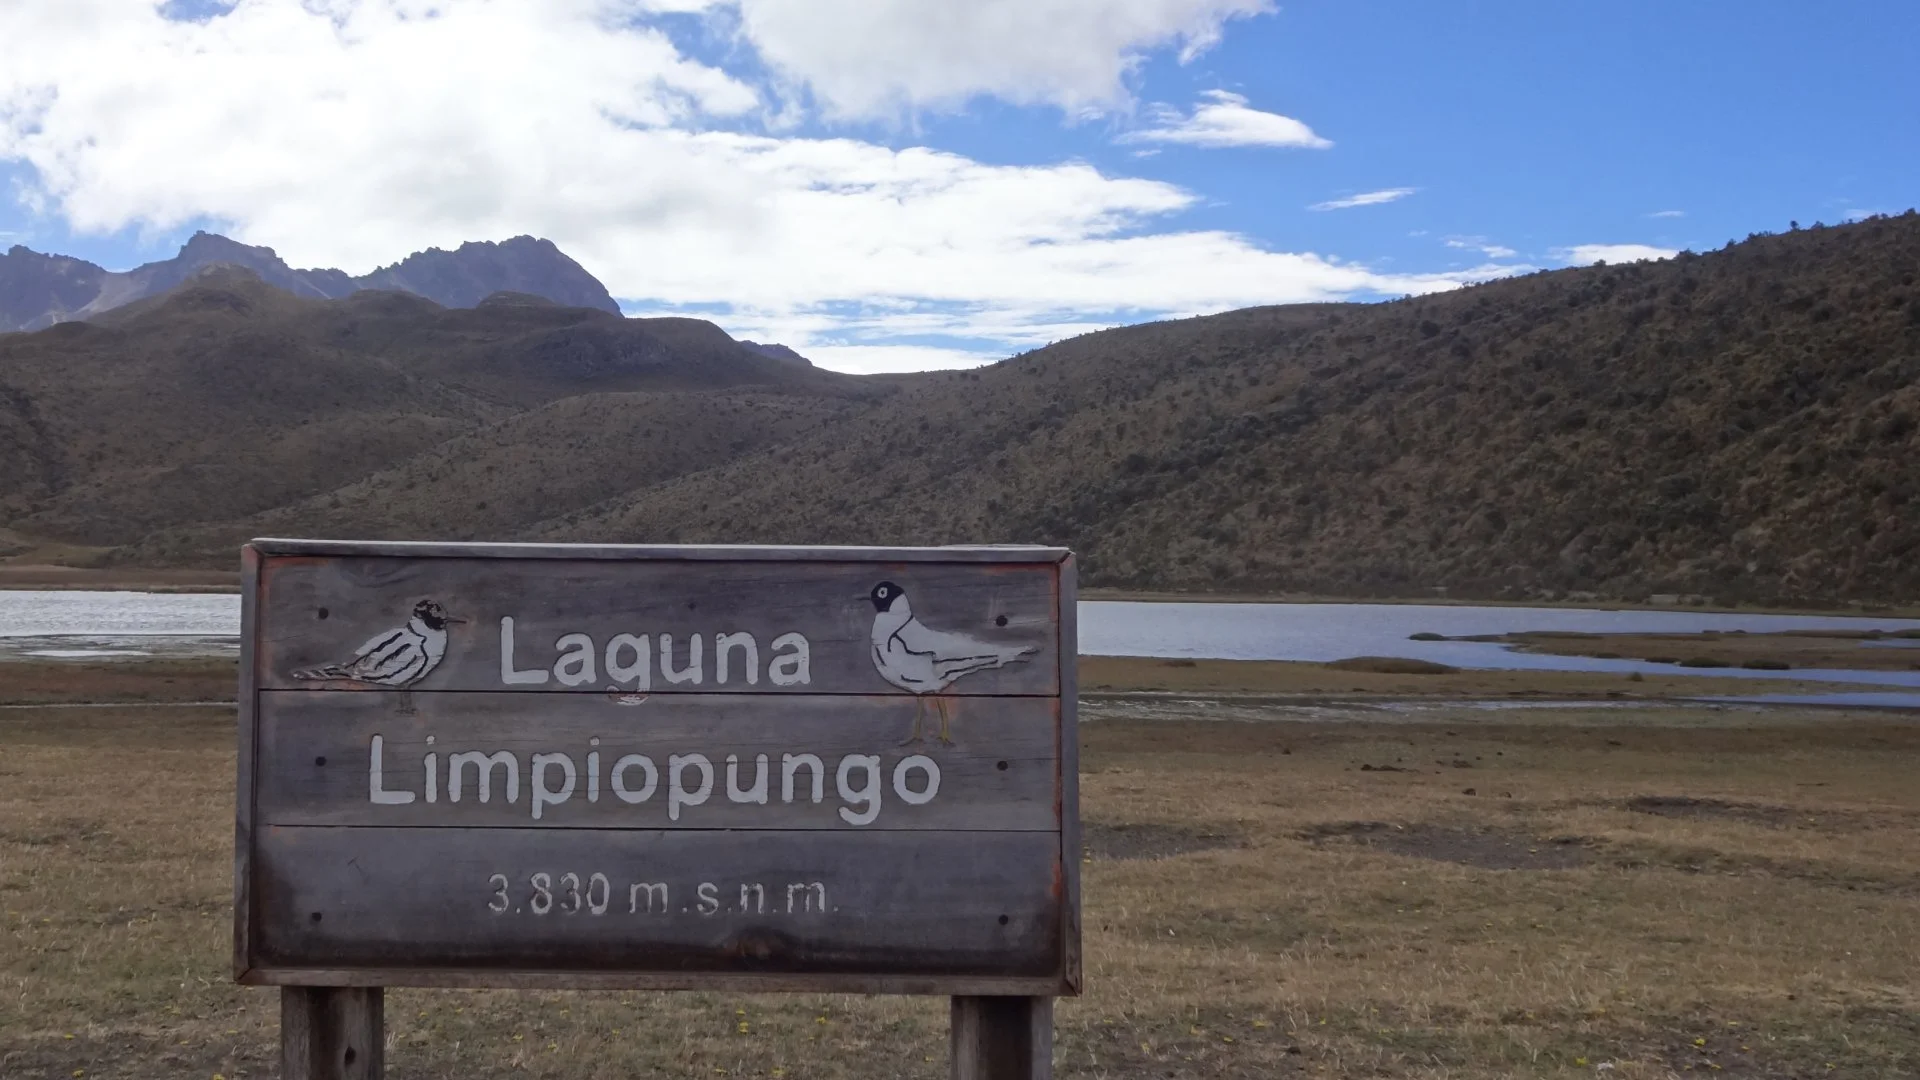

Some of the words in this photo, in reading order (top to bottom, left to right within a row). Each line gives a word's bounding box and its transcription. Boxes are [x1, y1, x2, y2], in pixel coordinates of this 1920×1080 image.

[500, 615, 811, 705] Laguna
[369, 733, 941, 826] Limpiopungo
[488, 872, 611, 915] 3.830
